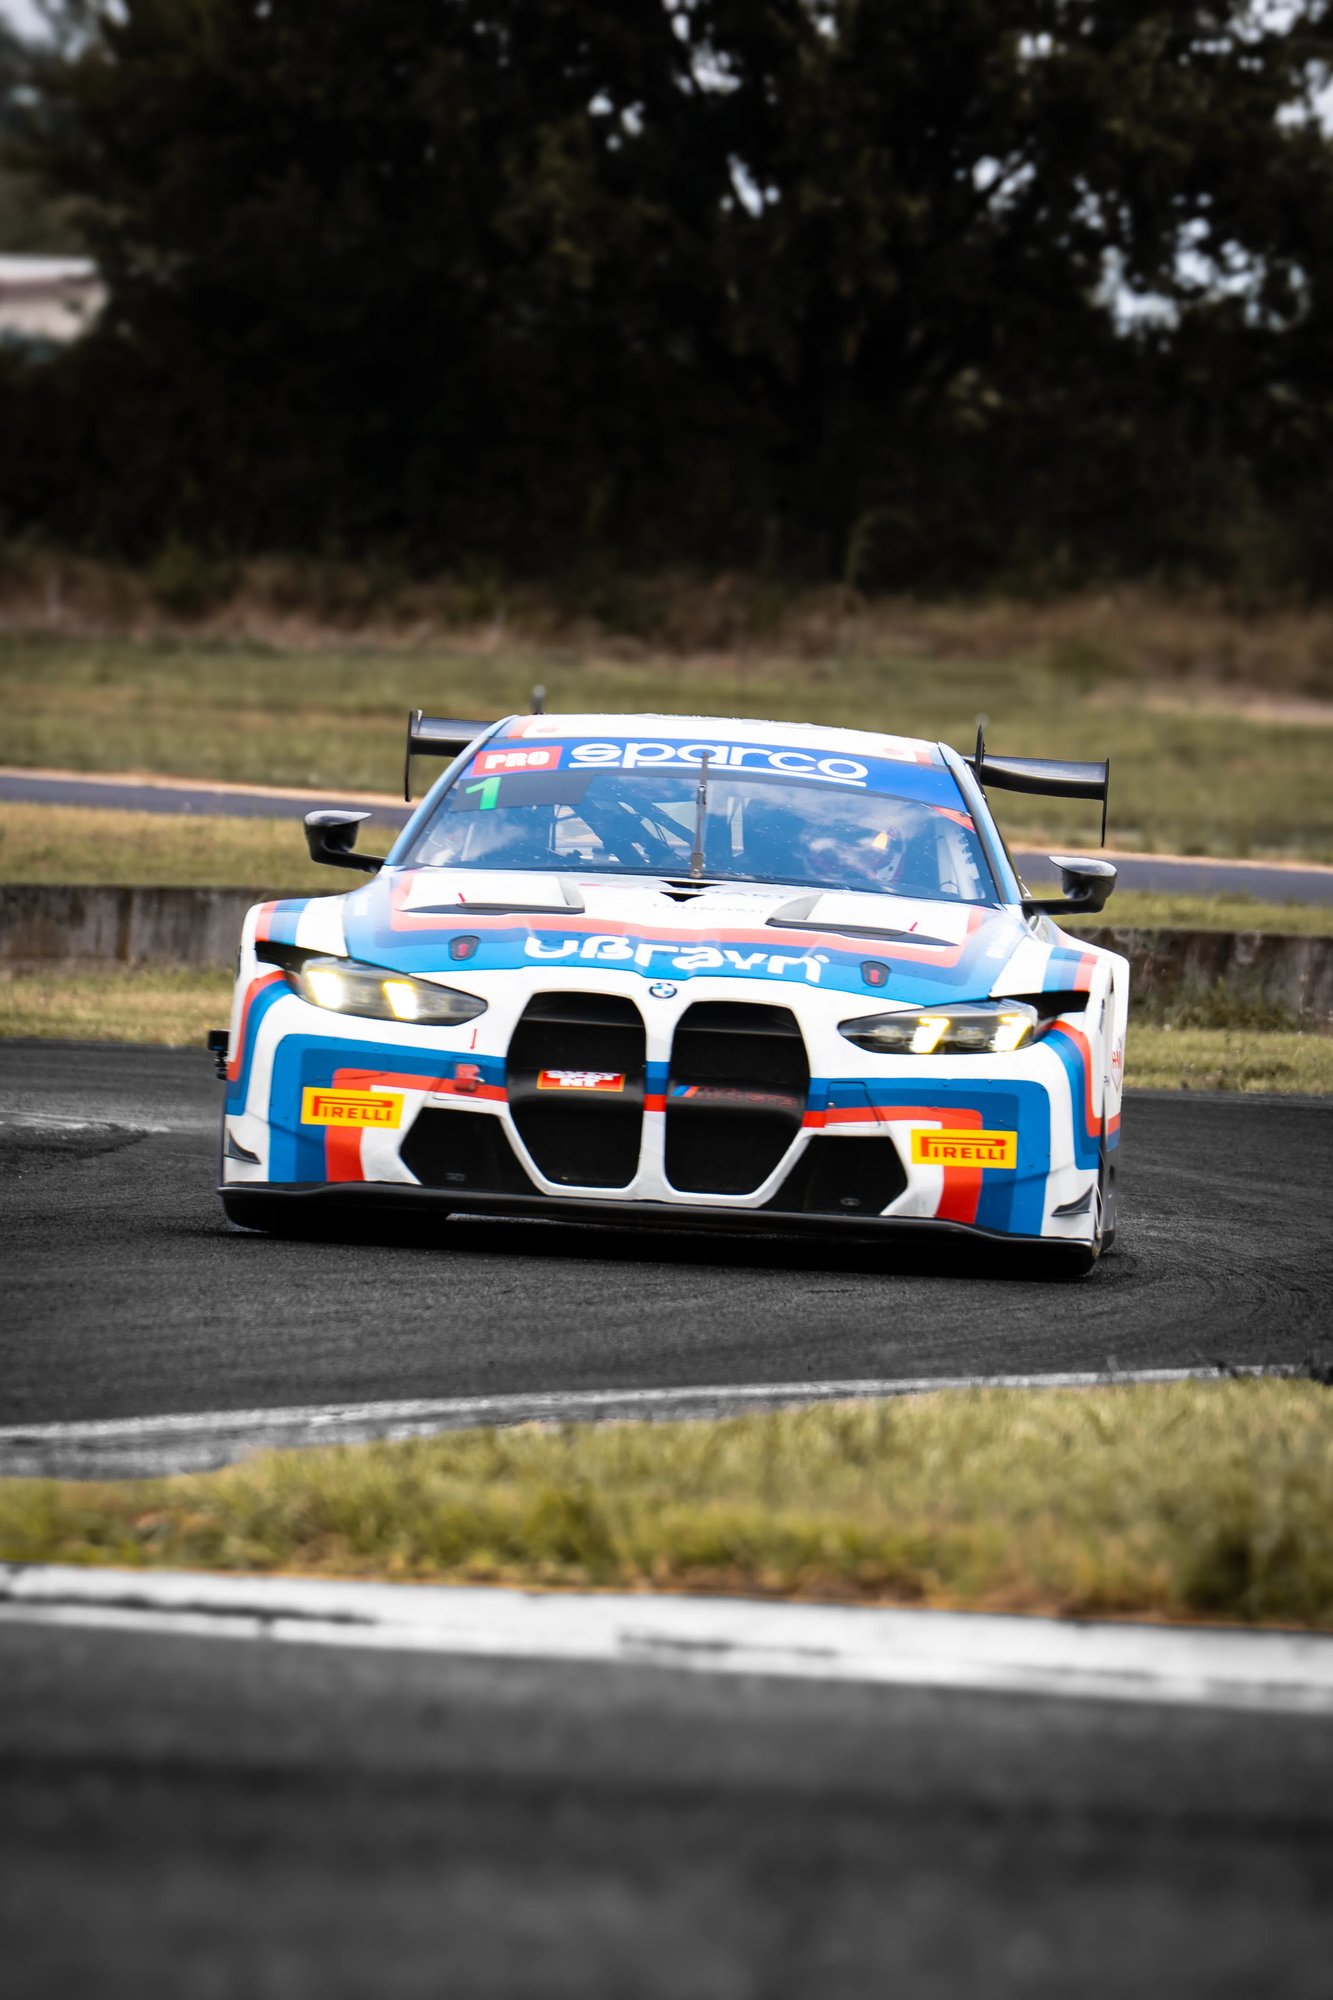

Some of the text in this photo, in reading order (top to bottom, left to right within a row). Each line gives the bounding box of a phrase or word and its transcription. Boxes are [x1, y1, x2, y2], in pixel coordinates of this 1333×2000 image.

[484, 750, 551, 770] PRO
[570, 742, 868, 781] sparco
[466, 776, 502, 811] 1
[312, 1095, 394, 1121] PIRELLI
[920, 1136, 1006, 1160] PIRELLI
